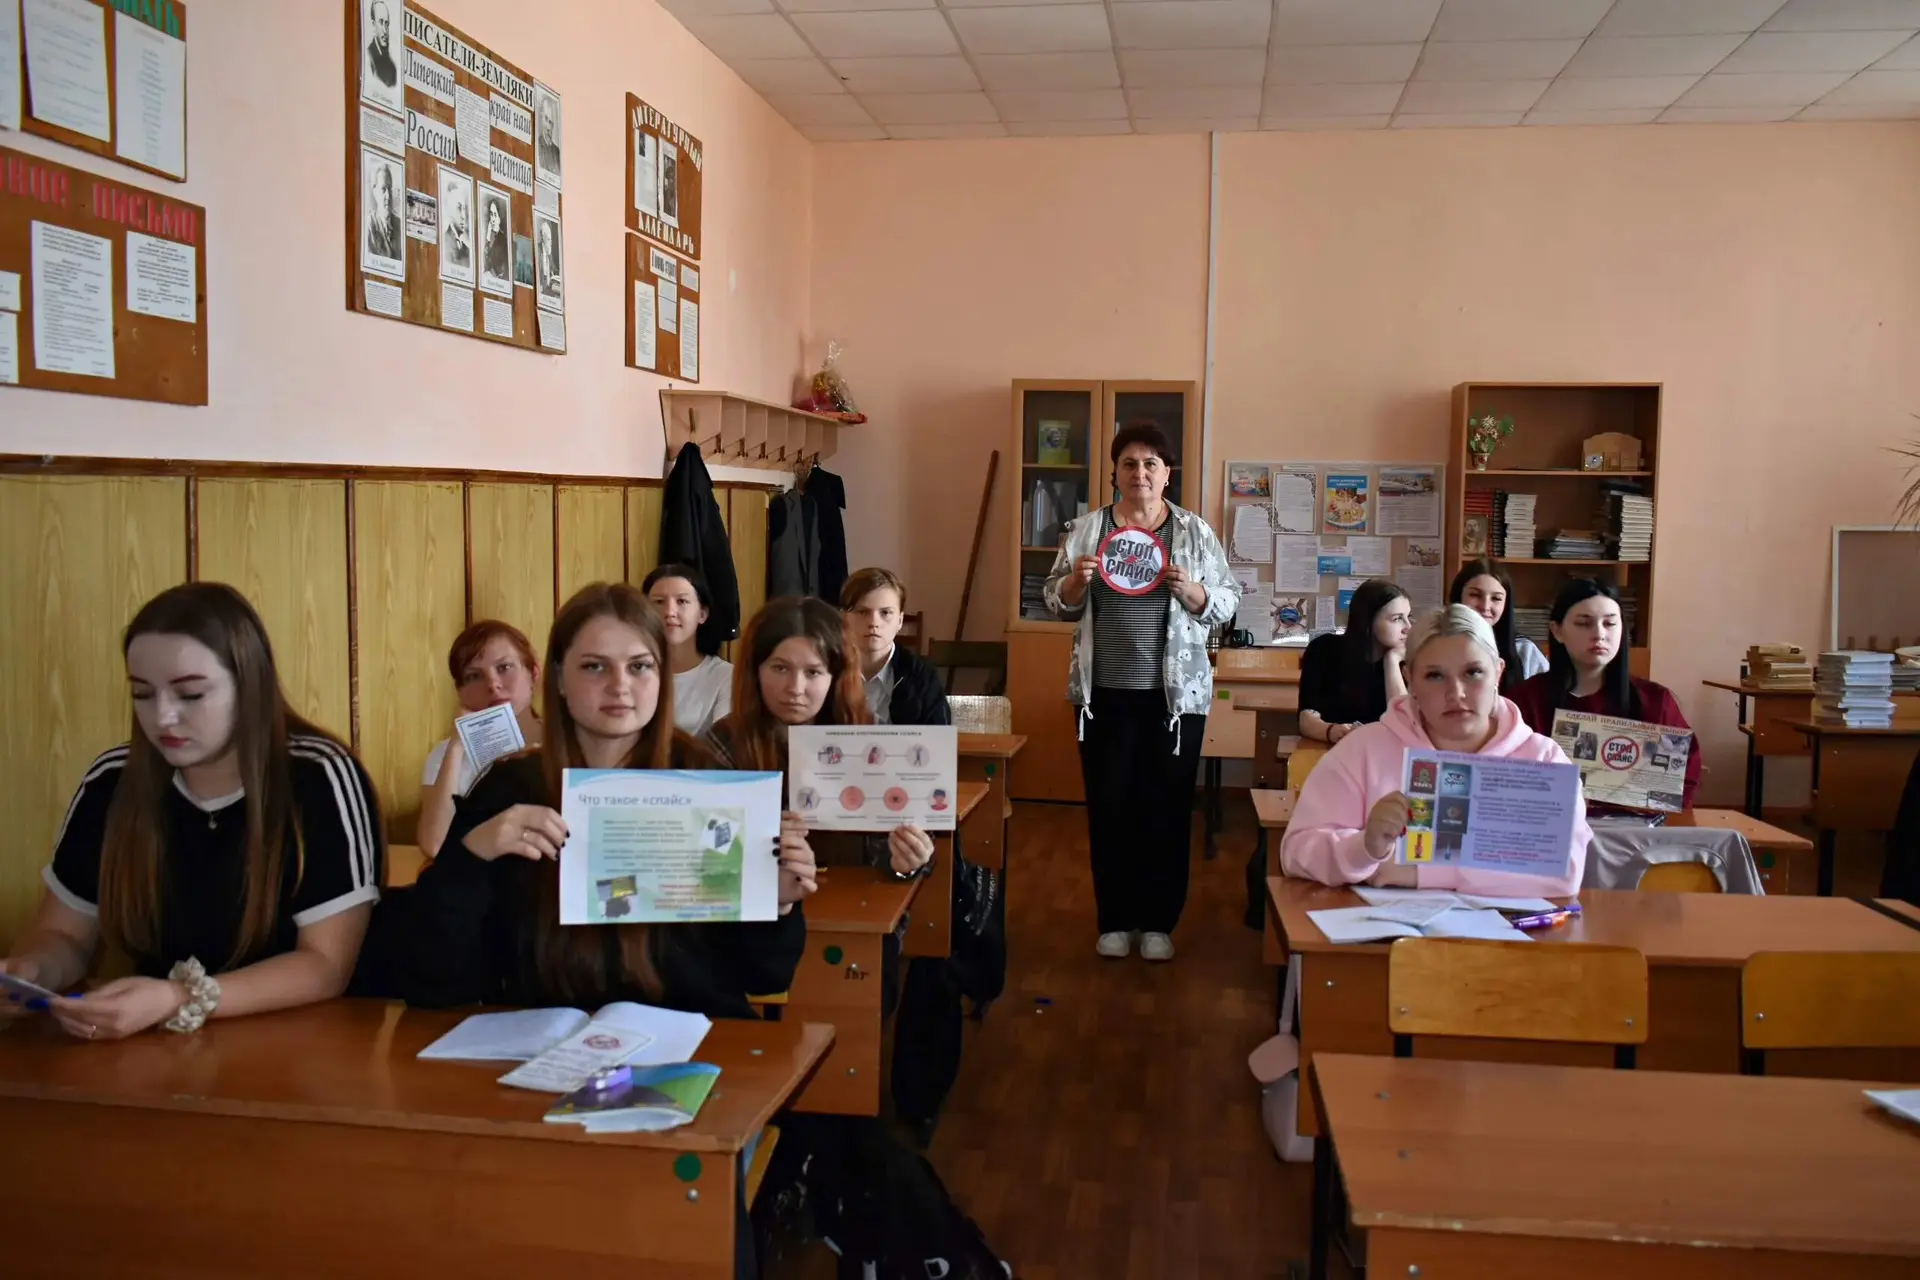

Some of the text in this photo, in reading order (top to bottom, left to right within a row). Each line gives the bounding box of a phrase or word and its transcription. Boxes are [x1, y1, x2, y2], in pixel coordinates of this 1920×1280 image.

[404, 10, 533, 107] ПИСАТЕЛИ-ЗЕМЛЯКИ
[404, 48, 454, 97] Липецкий
[406, 109, 455, 161] России
[490, 99, 531, 136] край наш
[632, 104, 702, 172] ЛИТЕРАТУРНЫЙ
[490, 151, 531, 193] частица
[639, 210, 694, 255] КАЛЕНДАРЬ
[1116, 538, 1154, 560] СТОП
[579, 794, 600, 806] Что
[604, 796, 638, 806] такое
